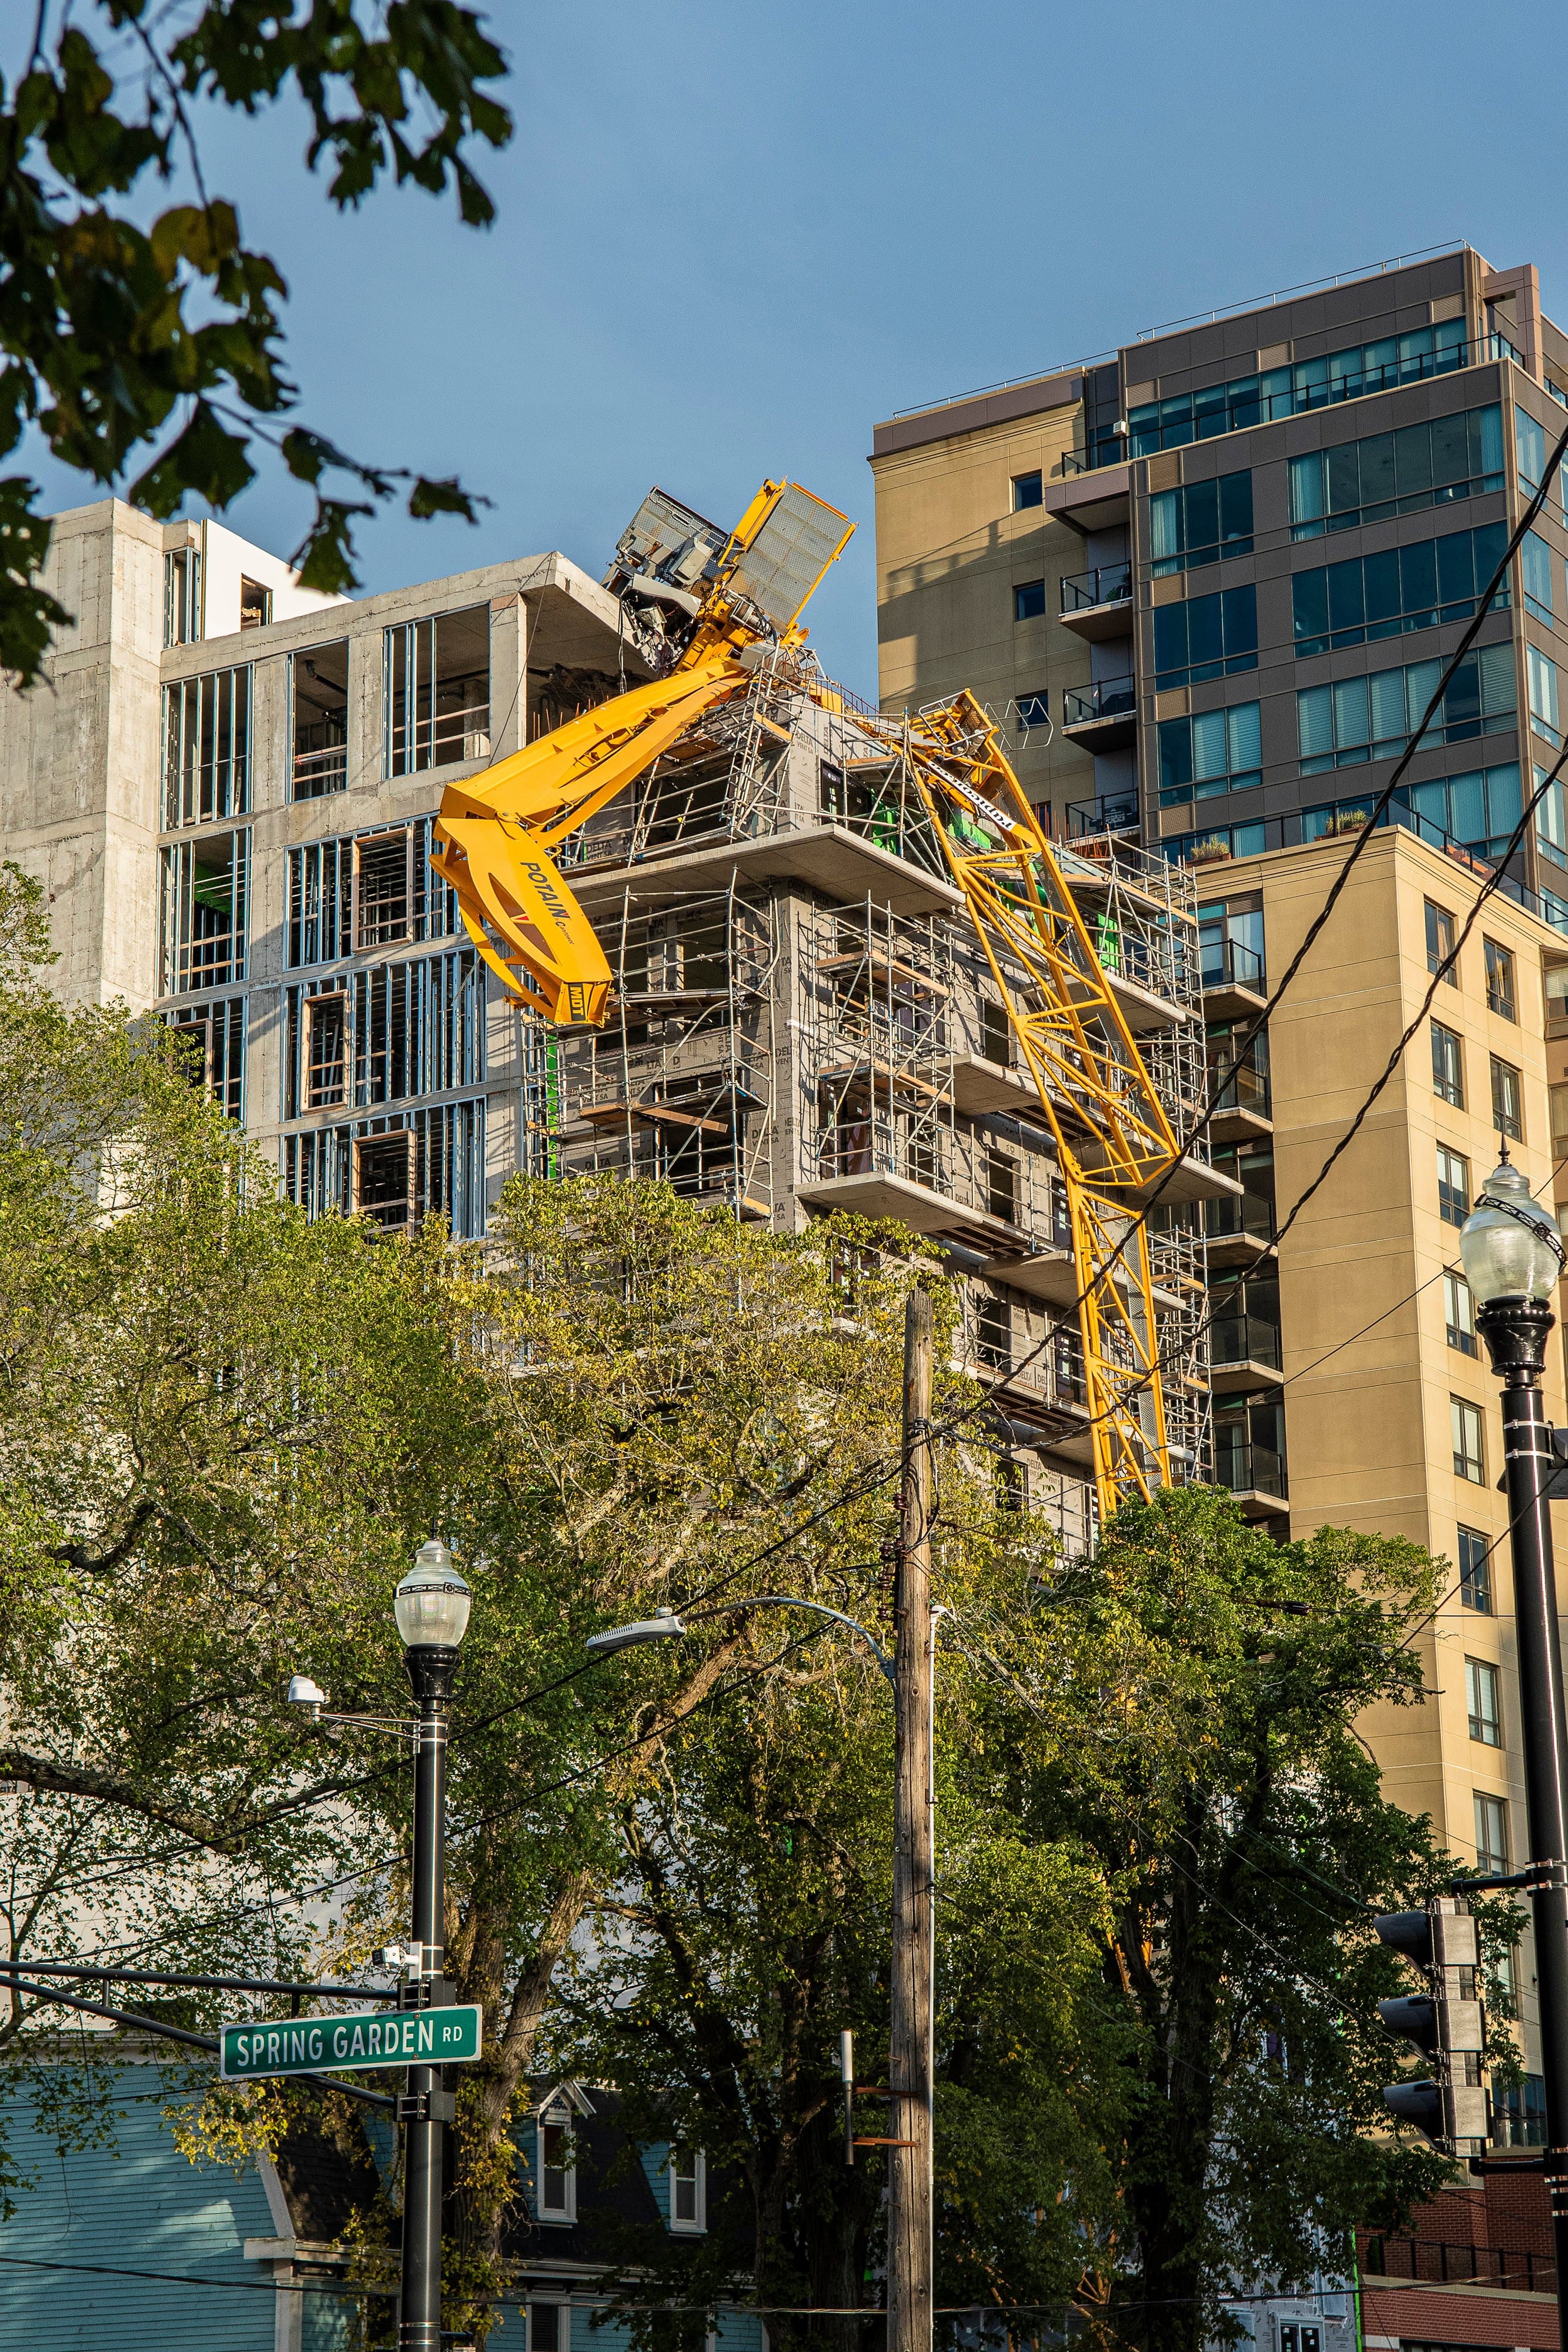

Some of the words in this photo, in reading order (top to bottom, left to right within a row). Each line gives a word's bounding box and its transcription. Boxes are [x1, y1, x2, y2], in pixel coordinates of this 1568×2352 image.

[796, 730, 813, 747] DELTA
[797, 740, 807, 752] VENT
[807, 745, 814, 754] SA
[587, 840, 611, 852] DELTA
[520, 862, 571, 919] POTAIN
[570, 987, 583, 1015] MDT
[1034, 1222, 1048, 1235] DELTA
[1038, 1374, 1047, 1384] DEL
[1027, 1458, 1042, 1471] DELTA
[238, 2028, 323, 2066] SPRING
[333, 2020, 434, 2058] GARDEN
[443, 2026, 463, 2042] RD
